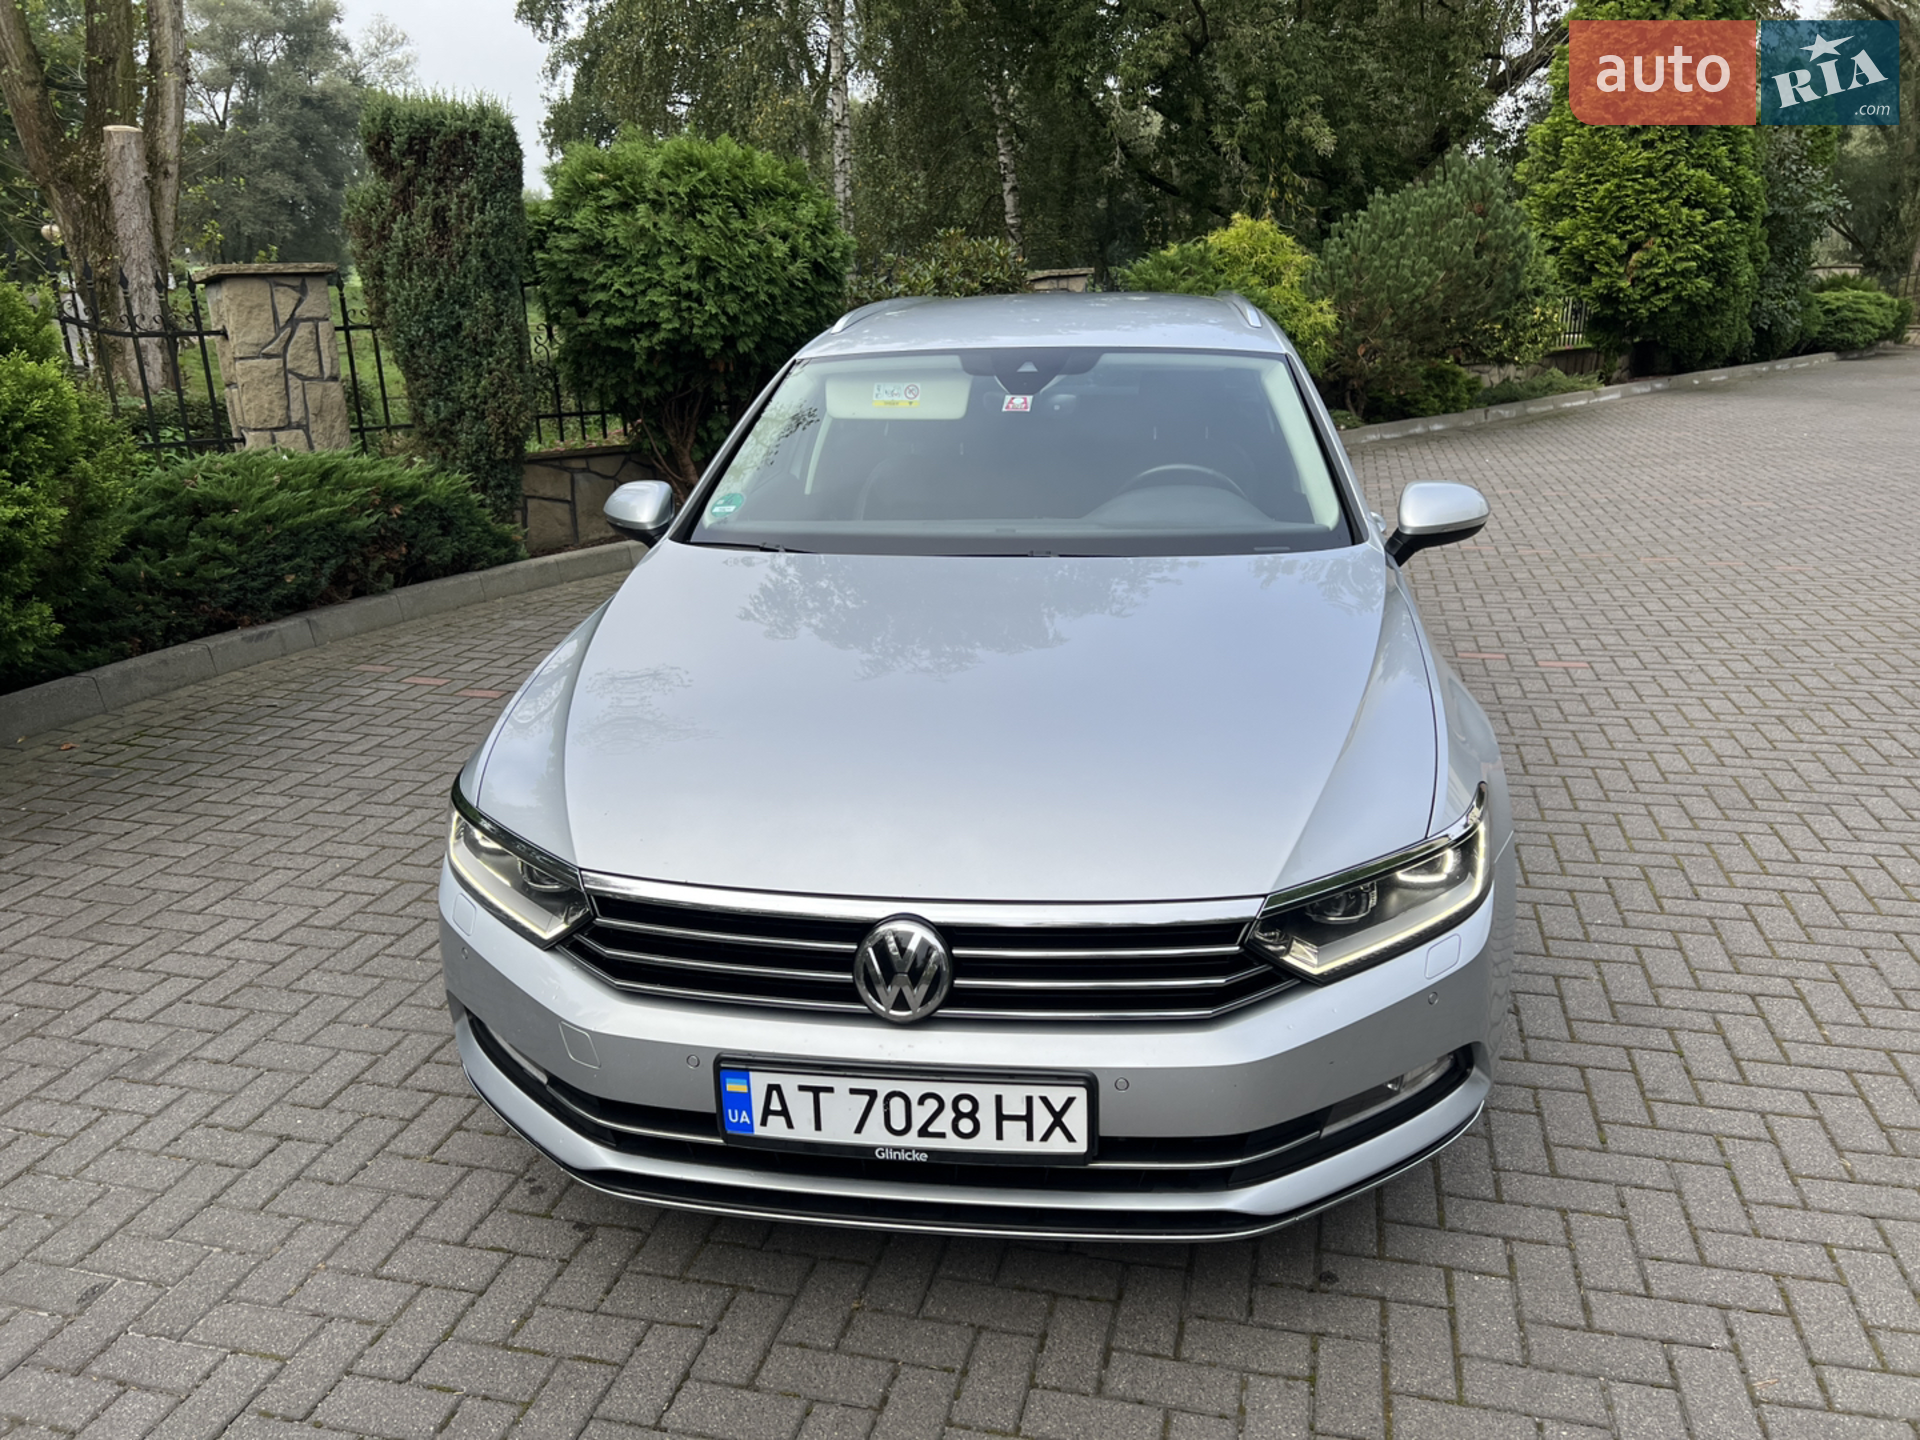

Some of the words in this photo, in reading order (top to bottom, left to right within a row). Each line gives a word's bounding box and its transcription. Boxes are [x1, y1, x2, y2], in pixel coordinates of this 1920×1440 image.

[728, 1109, 751, 1125] UA
[759, 1083, 835, 1132] AT
[848, 1087, 981, 1140] 7028
[994, 1094, 1077, 1143] HX
[875, 1147, 929, 1162] Glinicke
